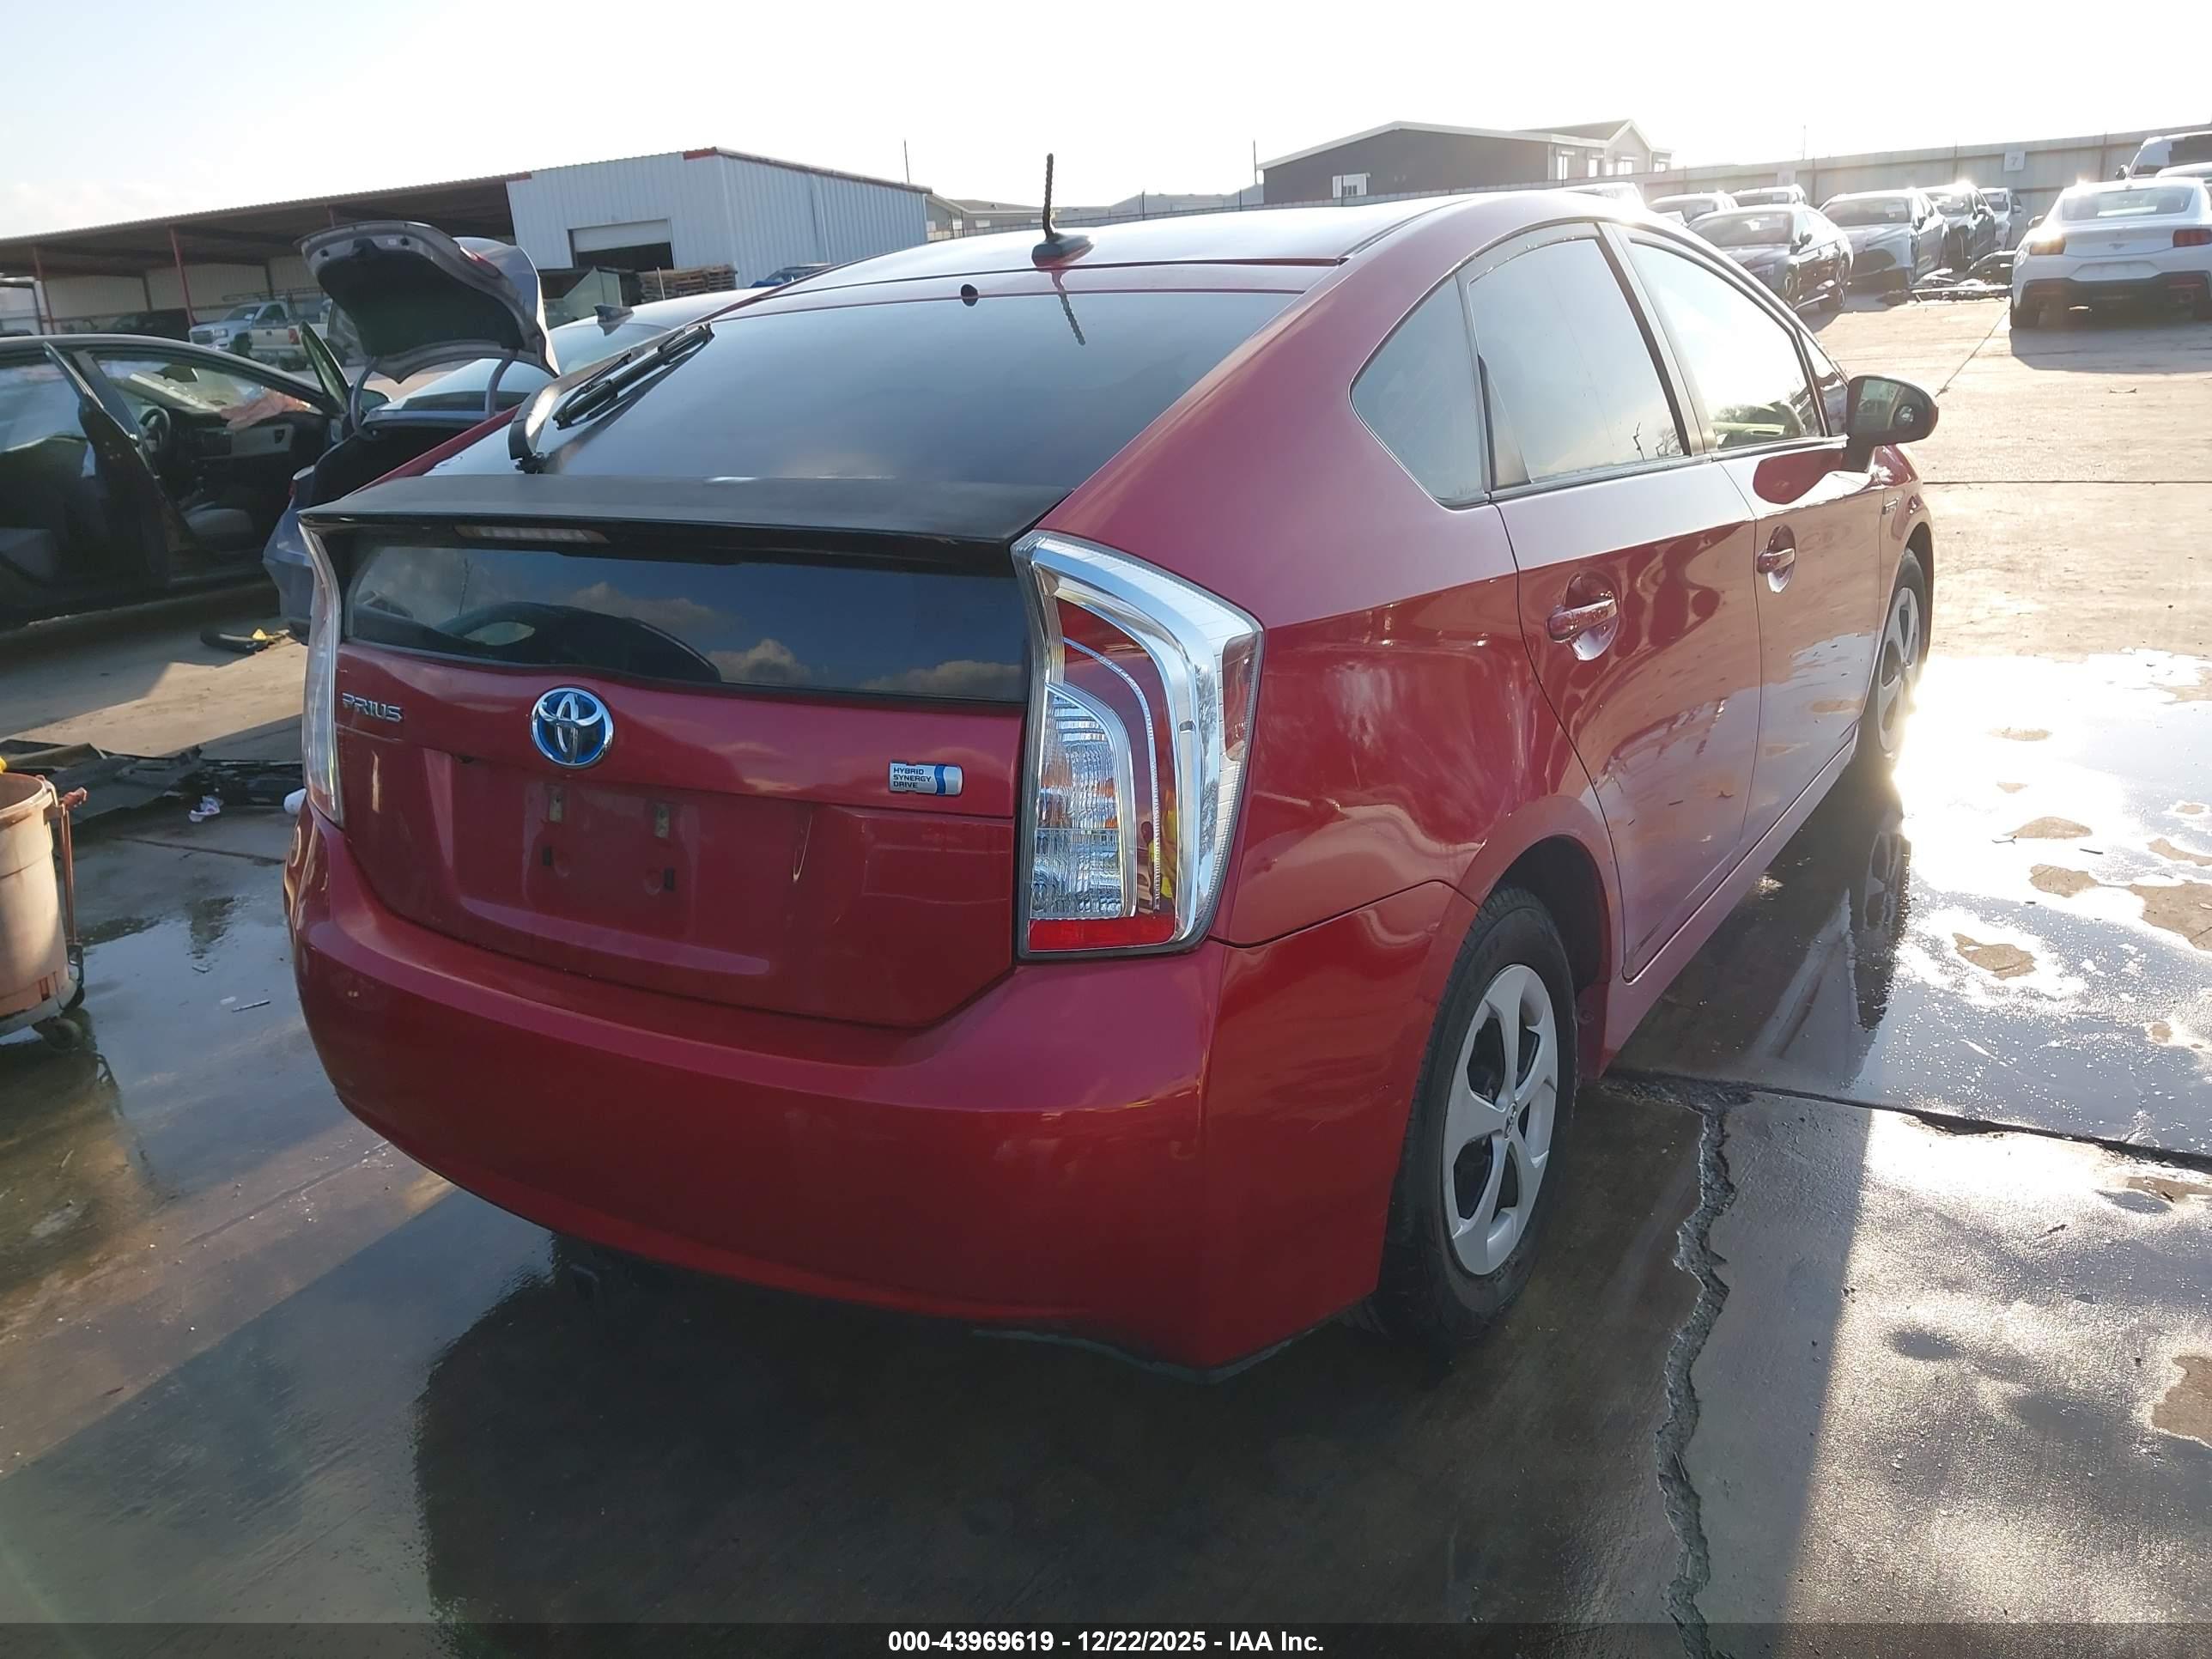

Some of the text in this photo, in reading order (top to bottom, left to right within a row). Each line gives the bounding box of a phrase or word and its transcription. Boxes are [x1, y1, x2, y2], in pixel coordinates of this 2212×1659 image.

[342, 691, 403, 722] PRIUS
[893, 767, 925, 775] HYBRID
[893, 774, 932, 782] SYNERGY
